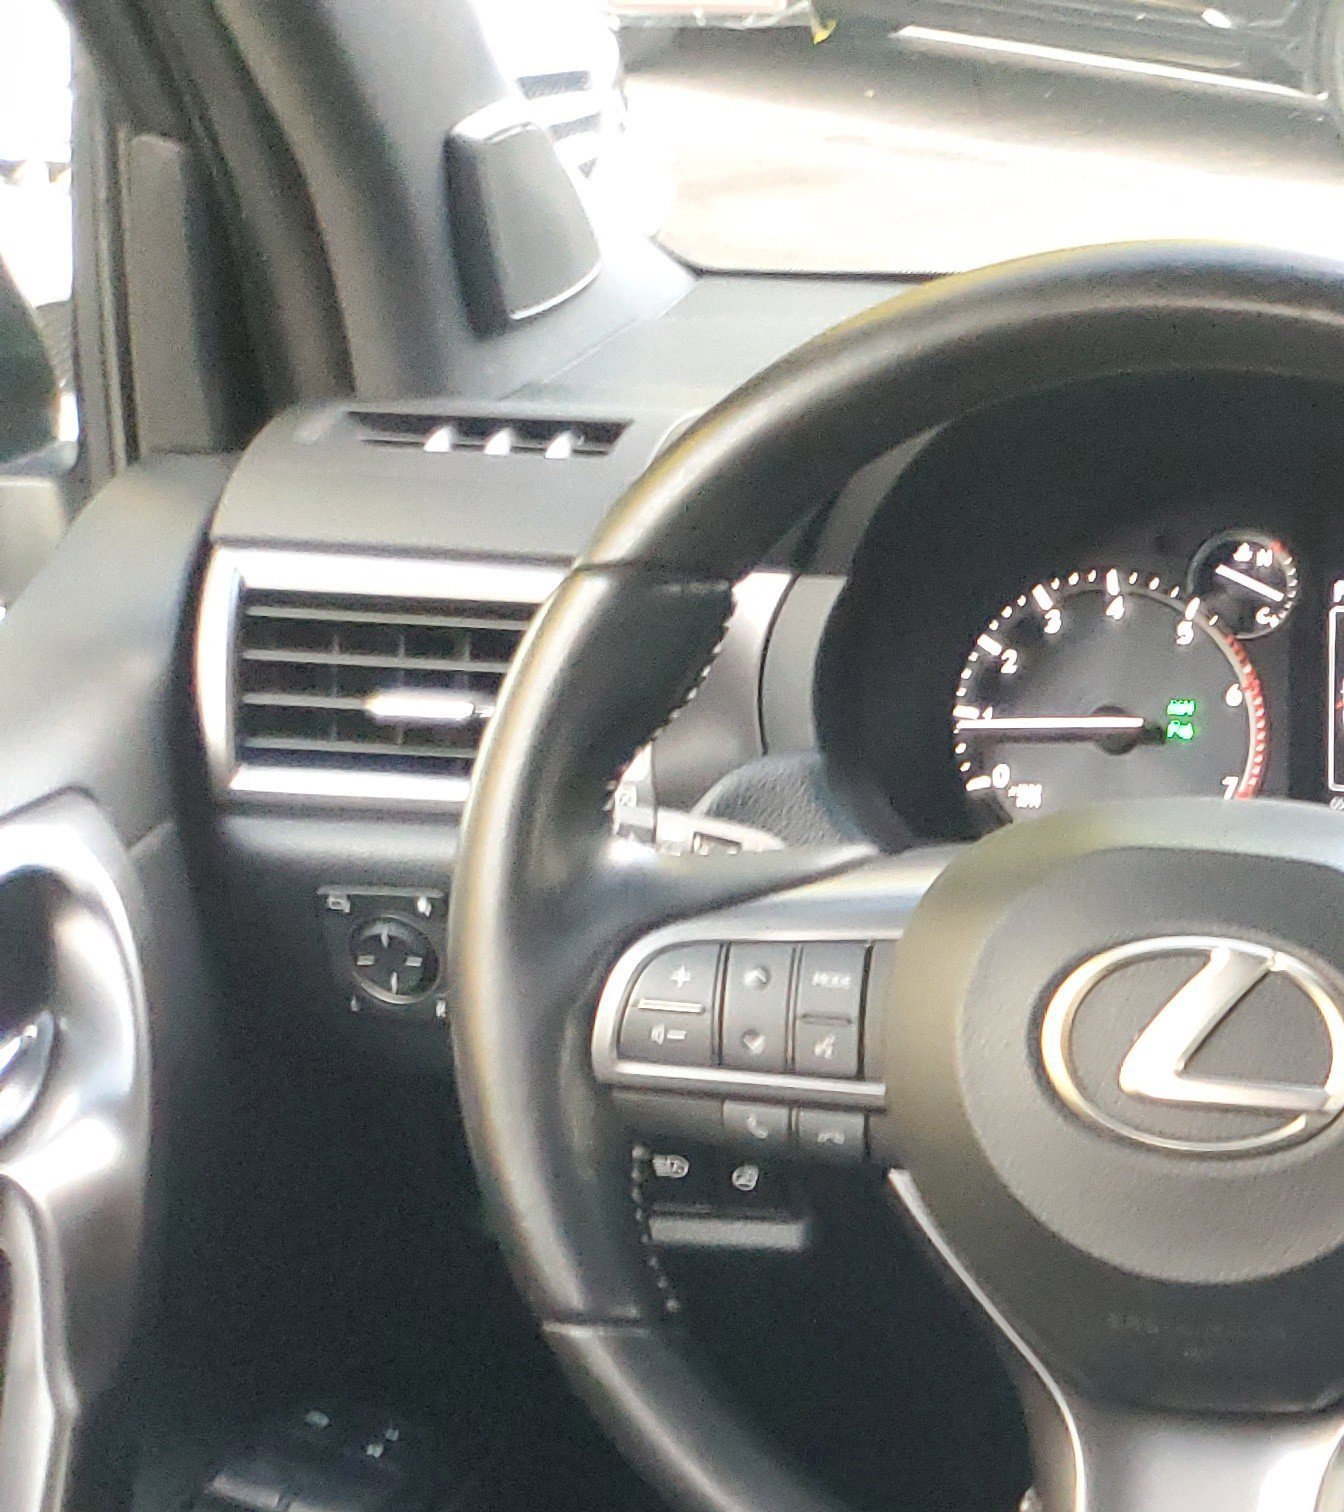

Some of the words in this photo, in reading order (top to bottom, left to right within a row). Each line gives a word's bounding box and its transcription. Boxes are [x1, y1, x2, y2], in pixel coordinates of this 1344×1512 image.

[1106, 595, 1125, 620] 4
[1044, 609, 1061, 634] 3
[1176, 620, 1194, 645] 5
[1001, 649, 1018, 674] 2
[1225, 684, 1242, 706] 6
[992, 763, 1010, 788] 0
[1221, 776, 1239, 800] 7
